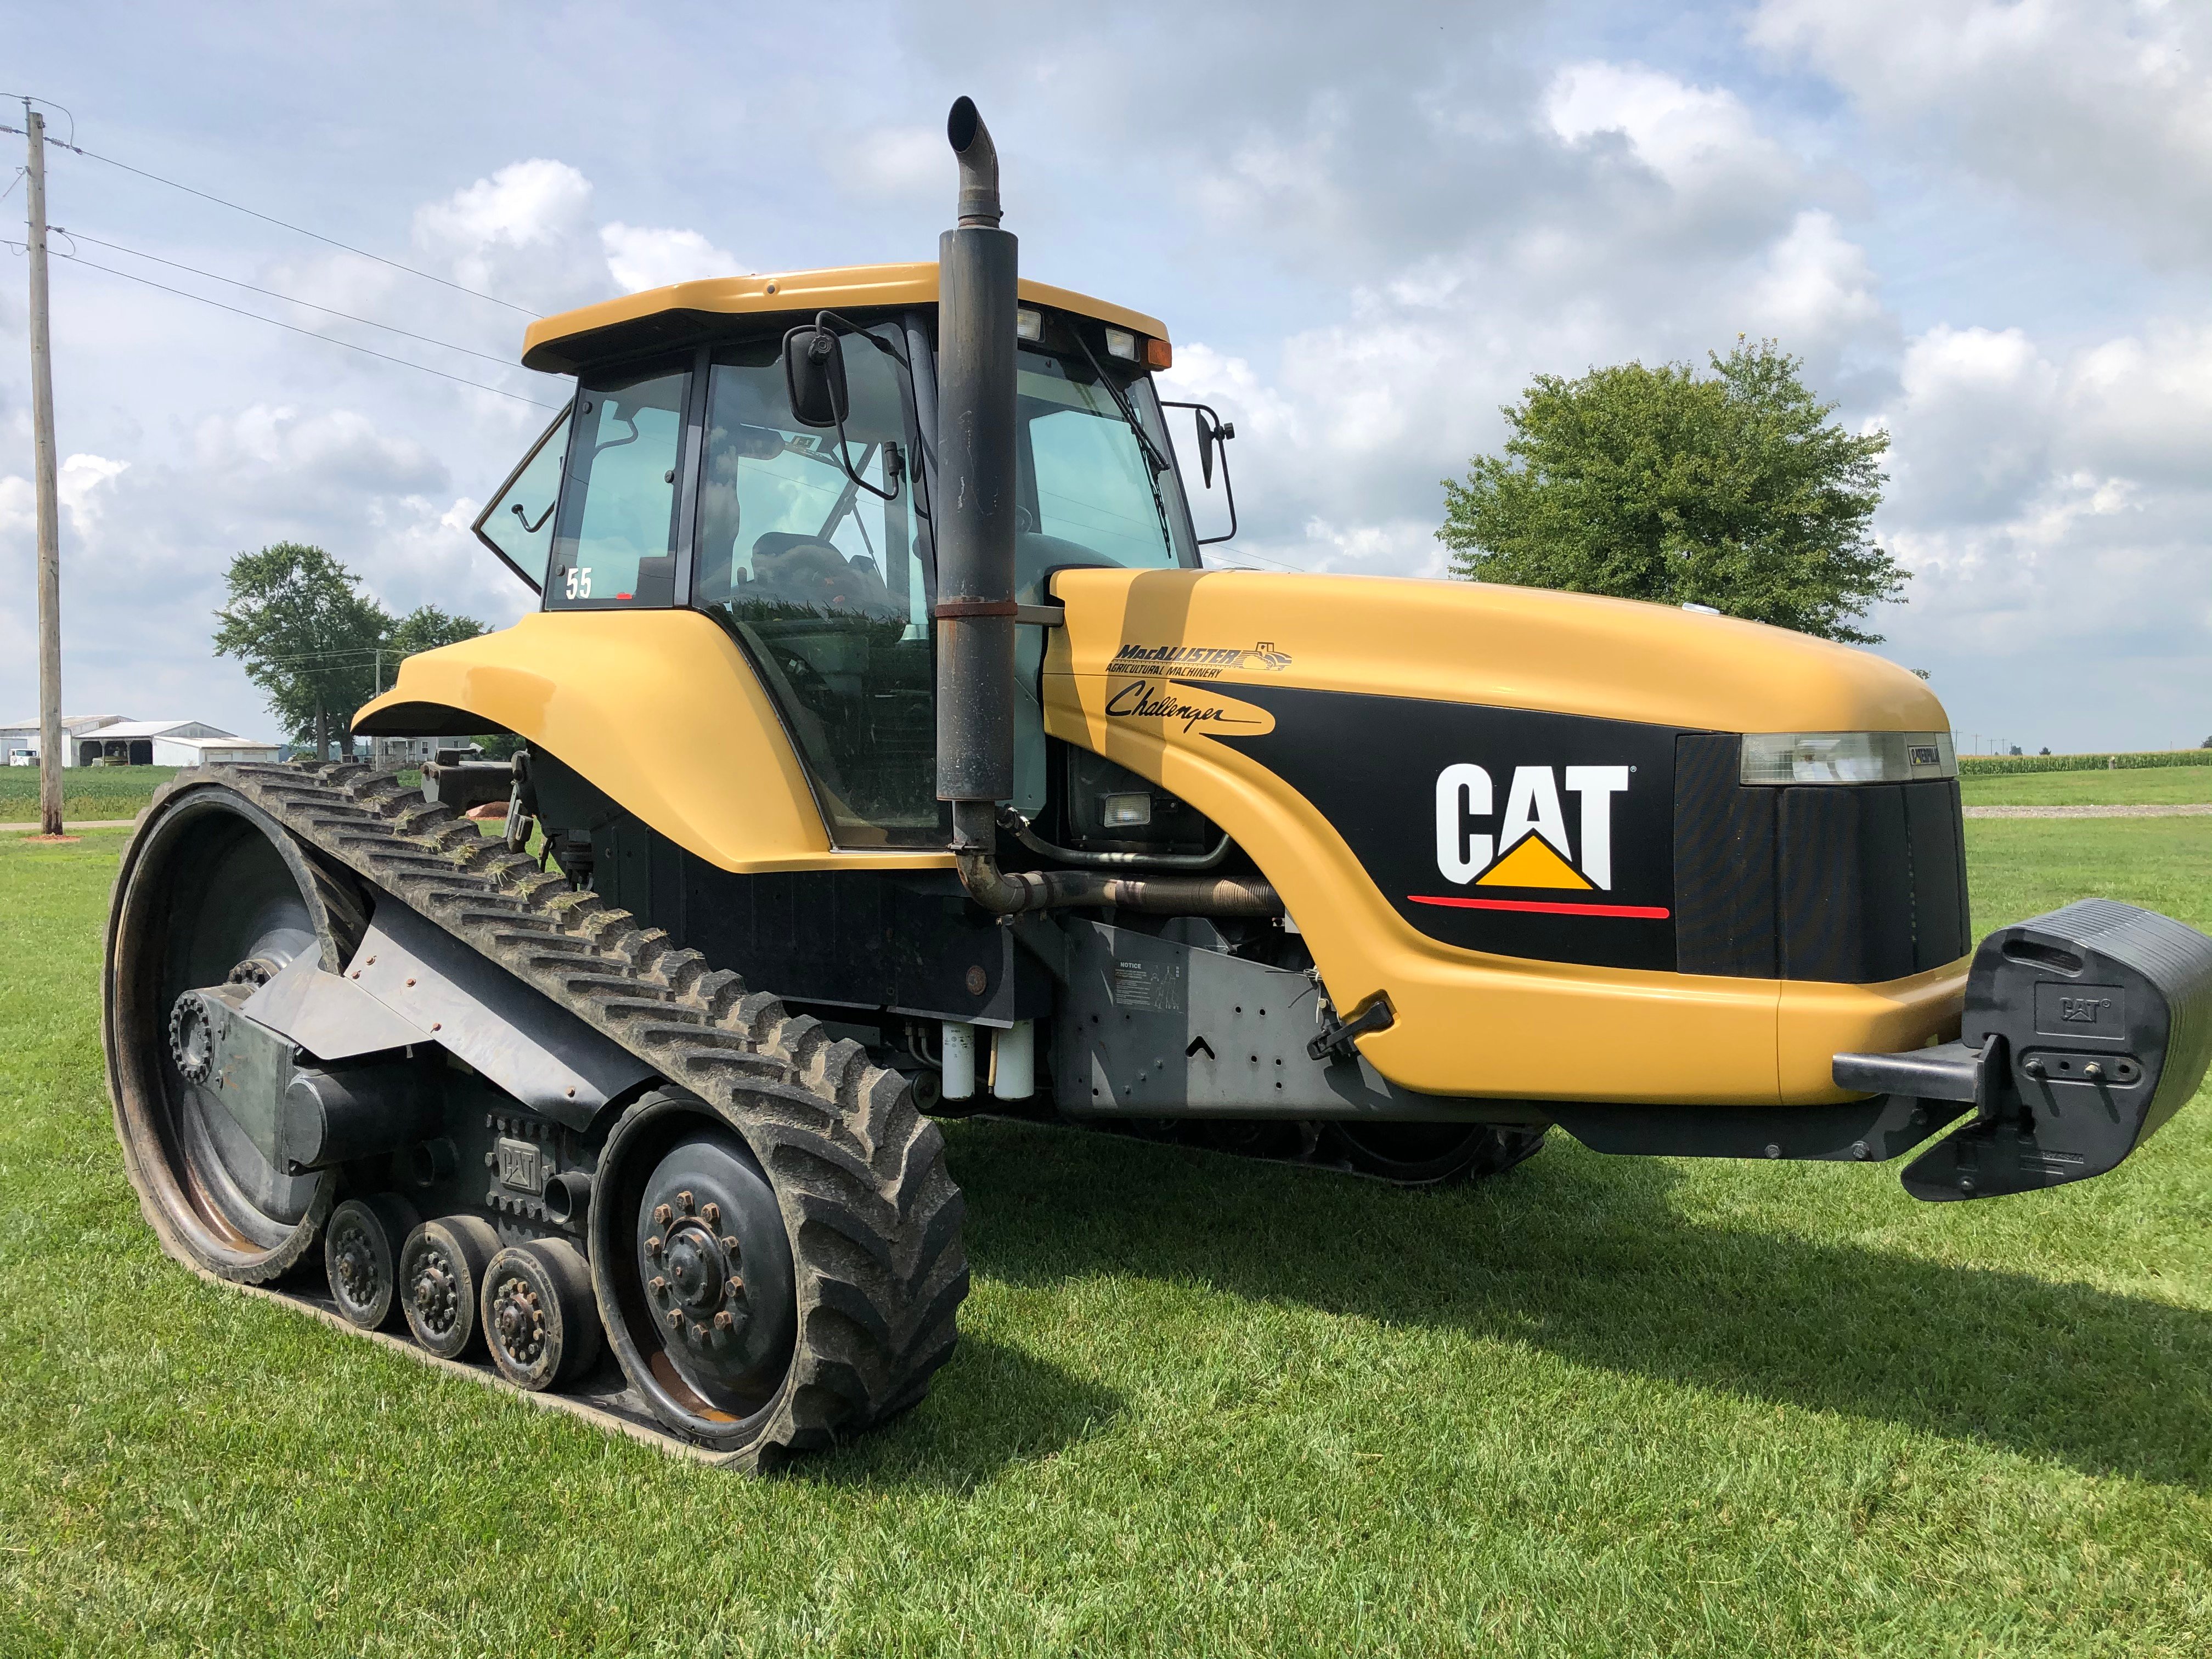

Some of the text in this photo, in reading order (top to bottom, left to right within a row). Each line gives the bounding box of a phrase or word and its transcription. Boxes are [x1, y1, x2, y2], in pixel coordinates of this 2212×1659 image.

[566, 567, 592, 599] 55
[1105, 663, 1223, 679] AGRICULTURAL MACHINERY
[1105, 680, 1262, 734] Challenger
[501, 1147, 534, 1189] CAT
